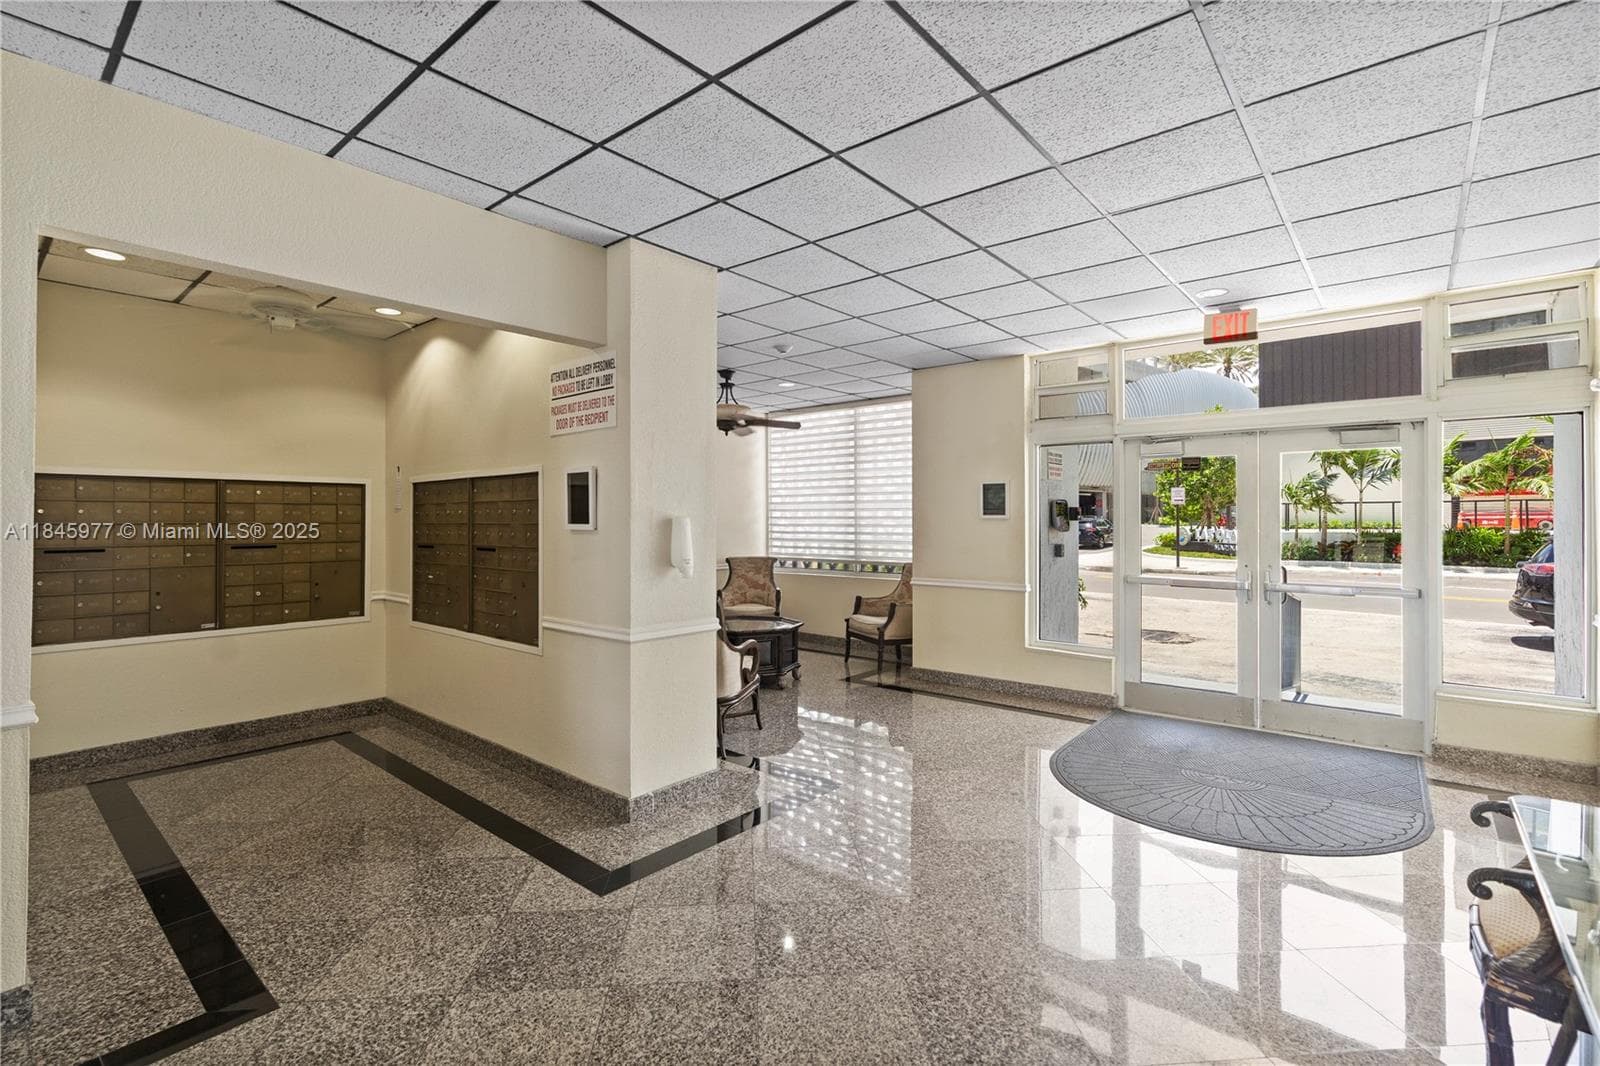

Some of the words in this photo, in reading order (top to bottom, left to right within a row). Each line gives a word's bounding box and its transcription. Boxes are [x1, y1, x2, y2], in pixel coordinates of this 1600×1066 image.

[1212, 312, 1249, 338] EXIT
[551, 370, 568, 383] ATTENTION
[576, 363, 592, 377] DELIVERY
[593, 358, 616, 373] PERSONNEL
[586, 377, 595, 390] LEFT
[596, 375, 599, 387] IN
[601, 373, 613, 386] LOBBY
[583, 397, 600, 411] DELIVERED
[602, 396, 606, 407] TO
[556, 418, 568, 430] DOOR
[569, 416, 575, 428] OF
[585, 411, 608, 424] RECIPIENT
